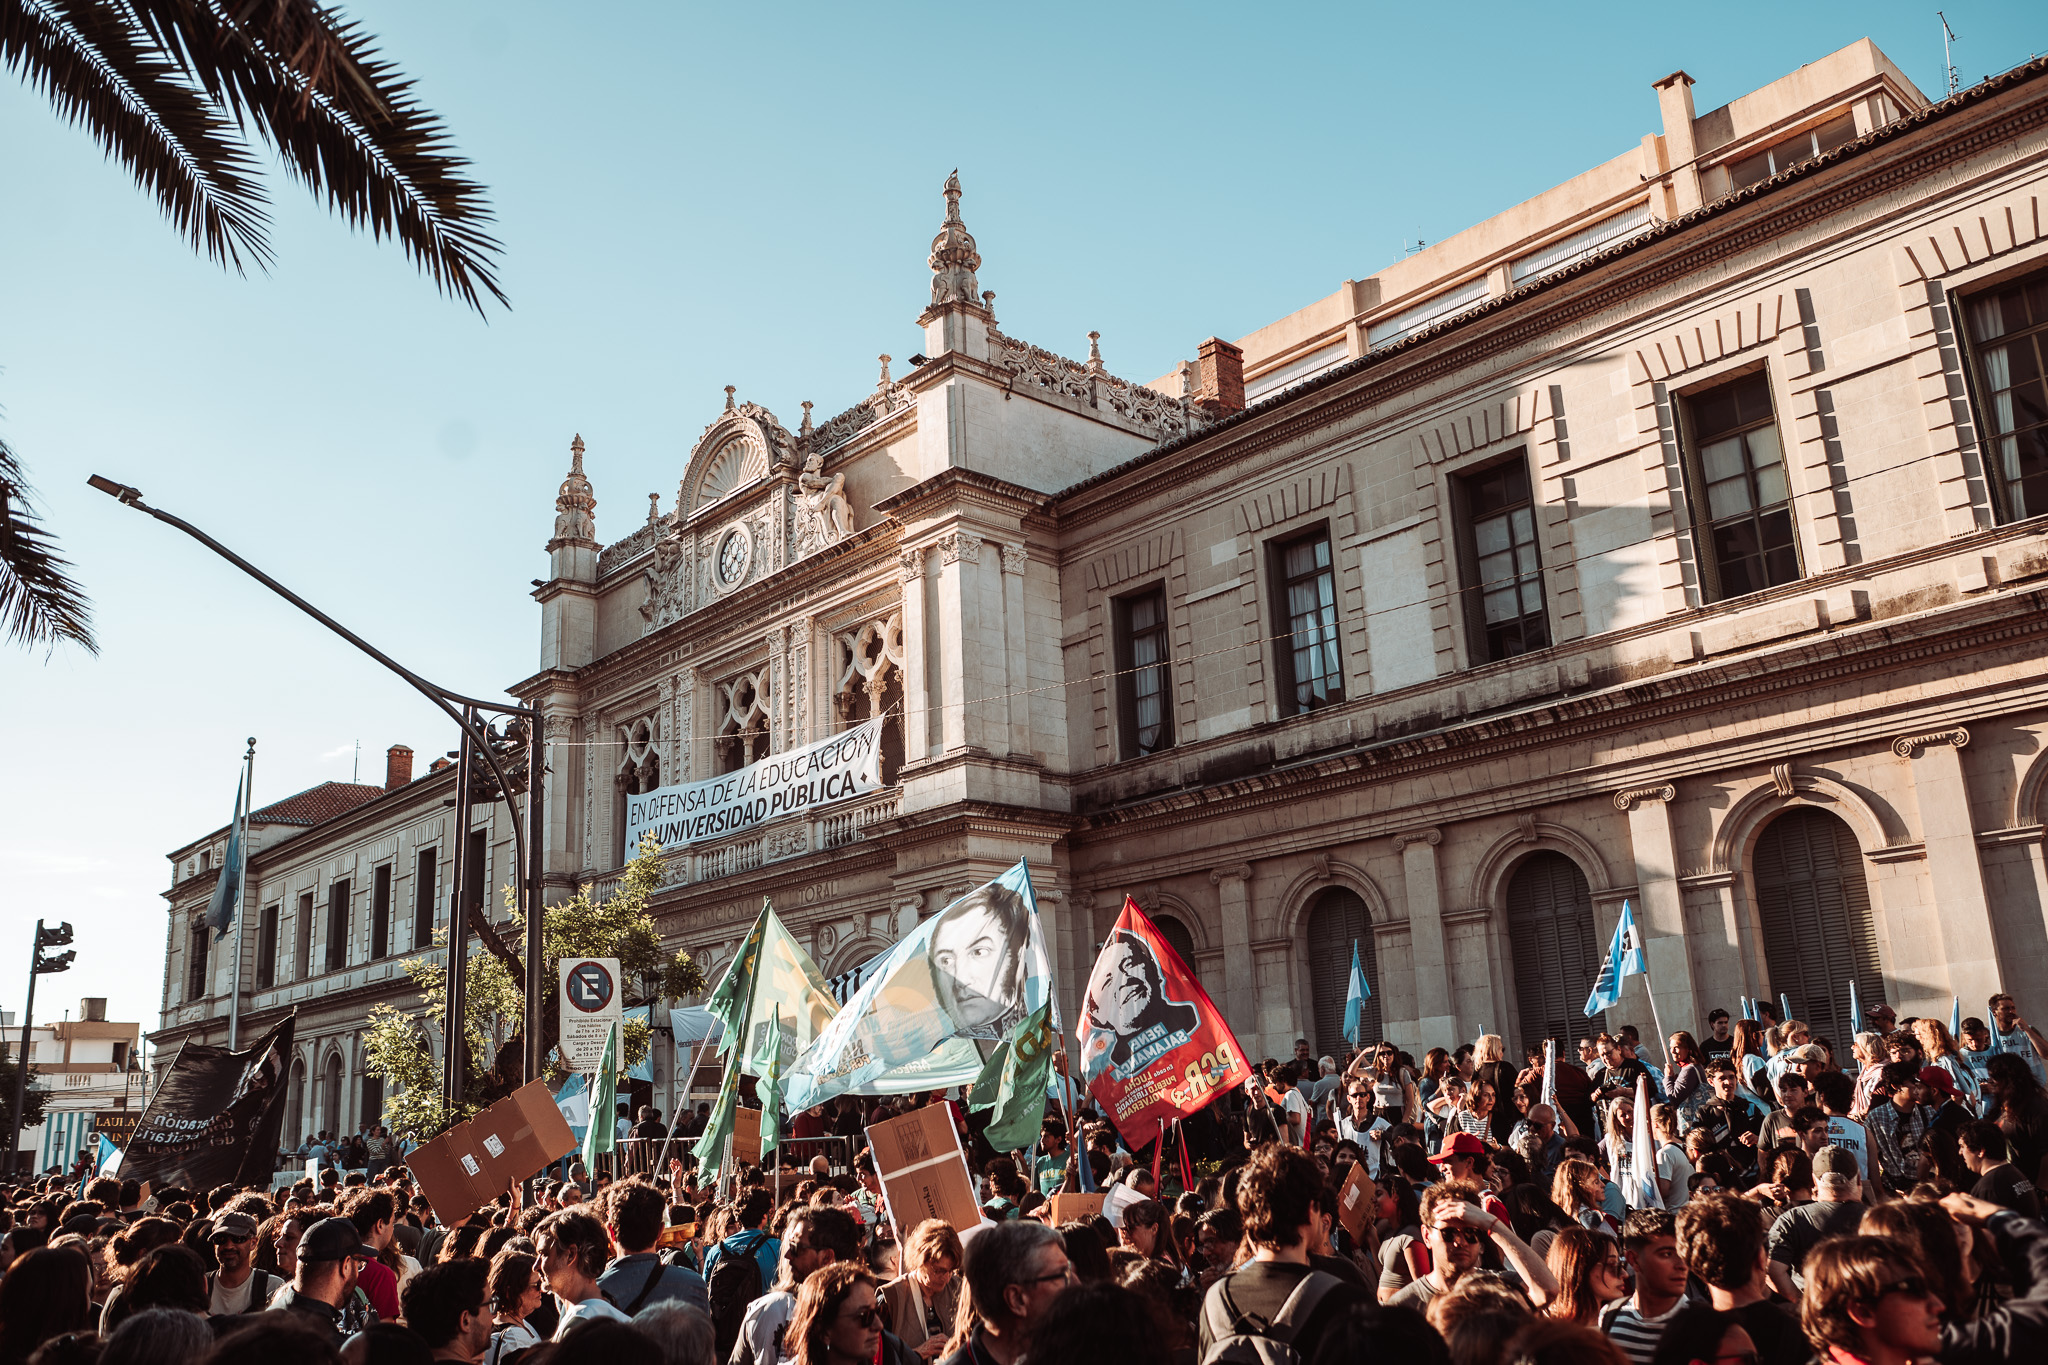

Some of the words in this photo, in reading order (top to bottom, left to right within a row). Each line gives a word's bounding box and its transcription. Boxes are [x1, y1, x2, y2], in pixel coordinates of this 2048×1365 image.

[630, 802, 646, 826] EN
[649, 788, 706, 821] DEFENSA
[711, 779, 736, 807] DE
[737, 774, 755, 797] LA
[759, 728, 876, 790] EDUCACIÓN
[658, 801, 767, 846] UNIVERSIDAD
[770, 770, 857, 816] PÚBLICA
[581, 973, 600, 1000] E
